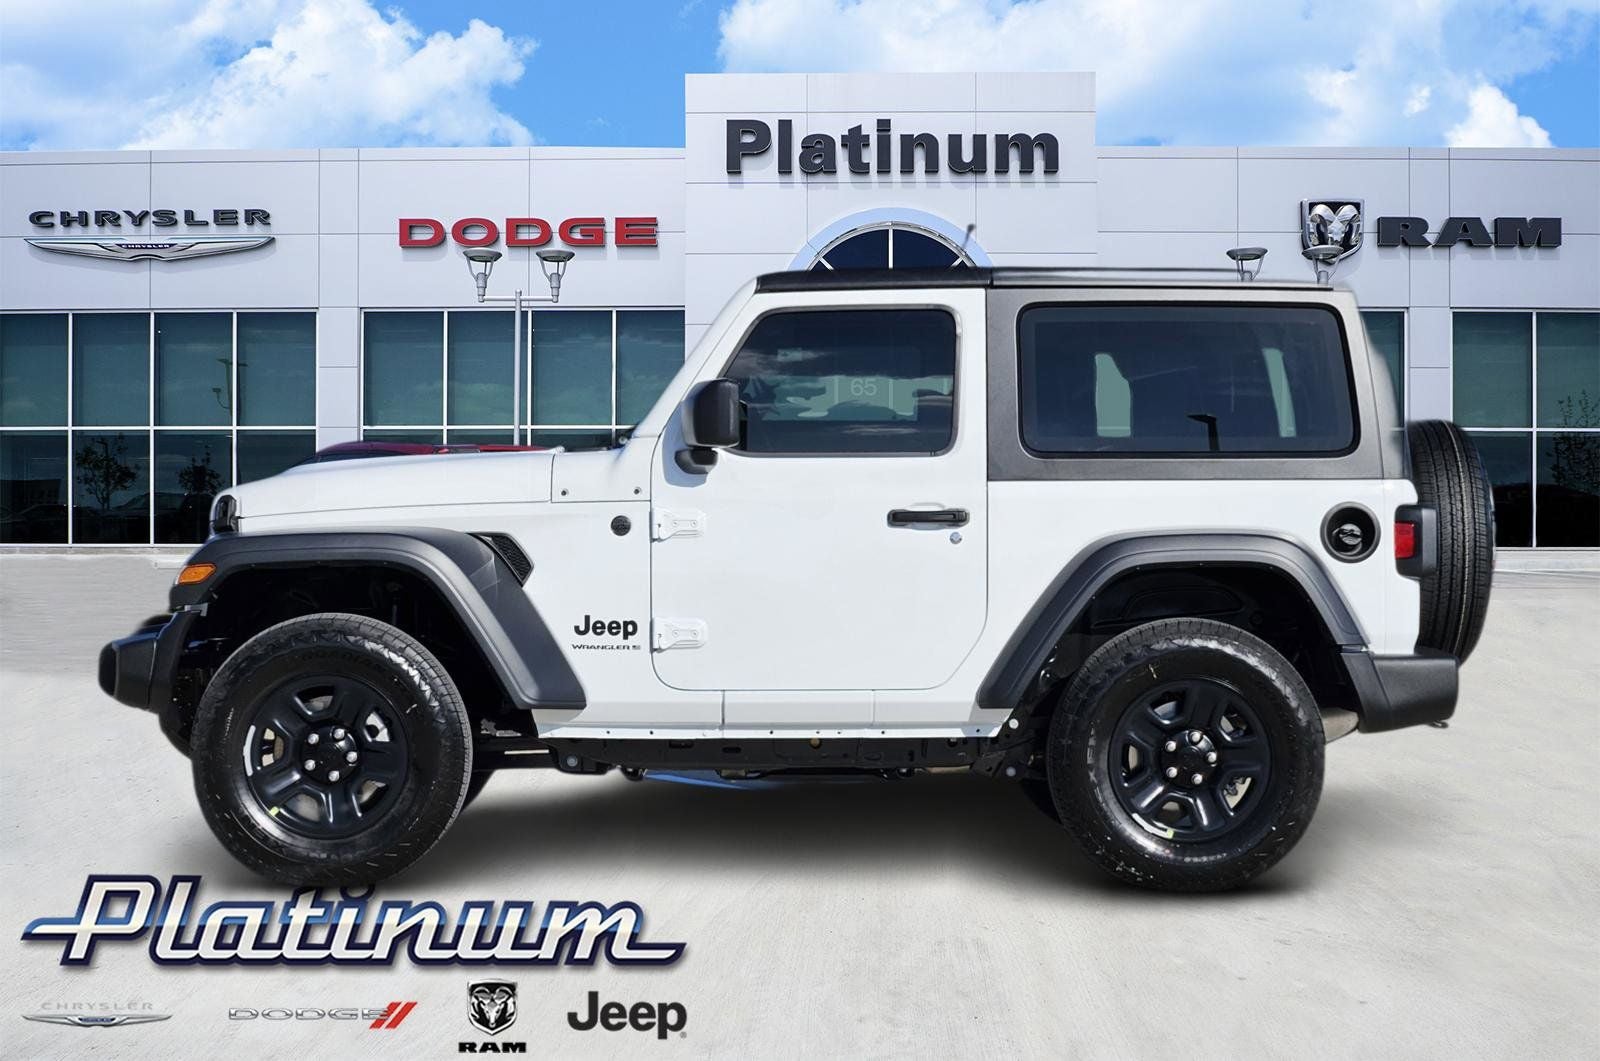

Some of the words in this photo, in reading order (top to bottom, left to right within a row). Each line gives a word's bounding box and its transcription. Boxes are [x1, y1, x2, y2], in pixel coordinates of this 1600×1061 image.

[726, 118, 1060, 174] Platinum
[28, 208, 272, 227] CHRYSLER
[399, 217, 658, 247] DODGE
[1377, 217, 1562, 248] RAM
[574, 615, 638, 640] Jeep
